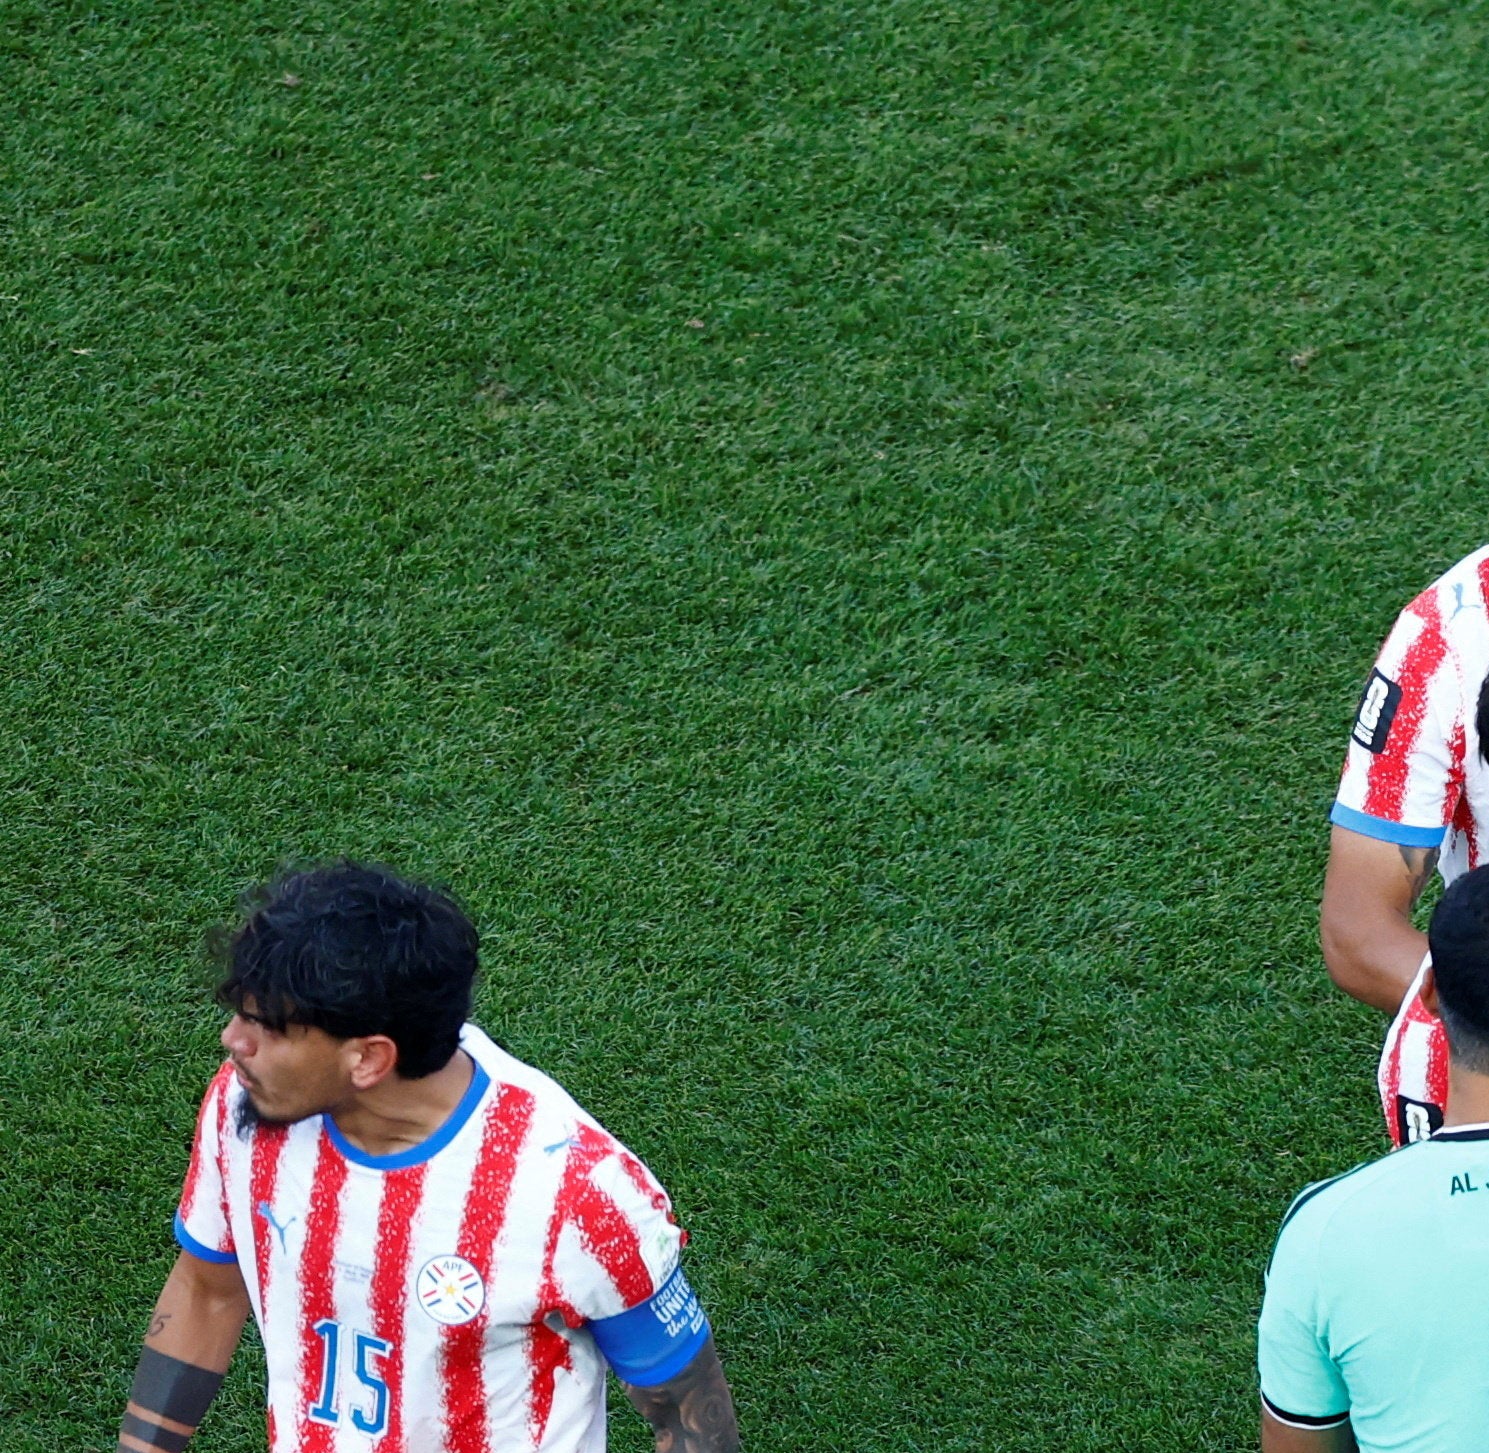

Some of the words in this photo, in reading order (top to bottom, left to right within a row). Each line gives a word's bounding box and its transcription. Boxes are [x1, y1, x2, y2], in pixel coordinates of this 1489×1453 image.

[1450, 1172, 1479, 1196] AL
[655, 1277, 690, 1324] UNITE
[308, 1317, 394, 1440] 15
